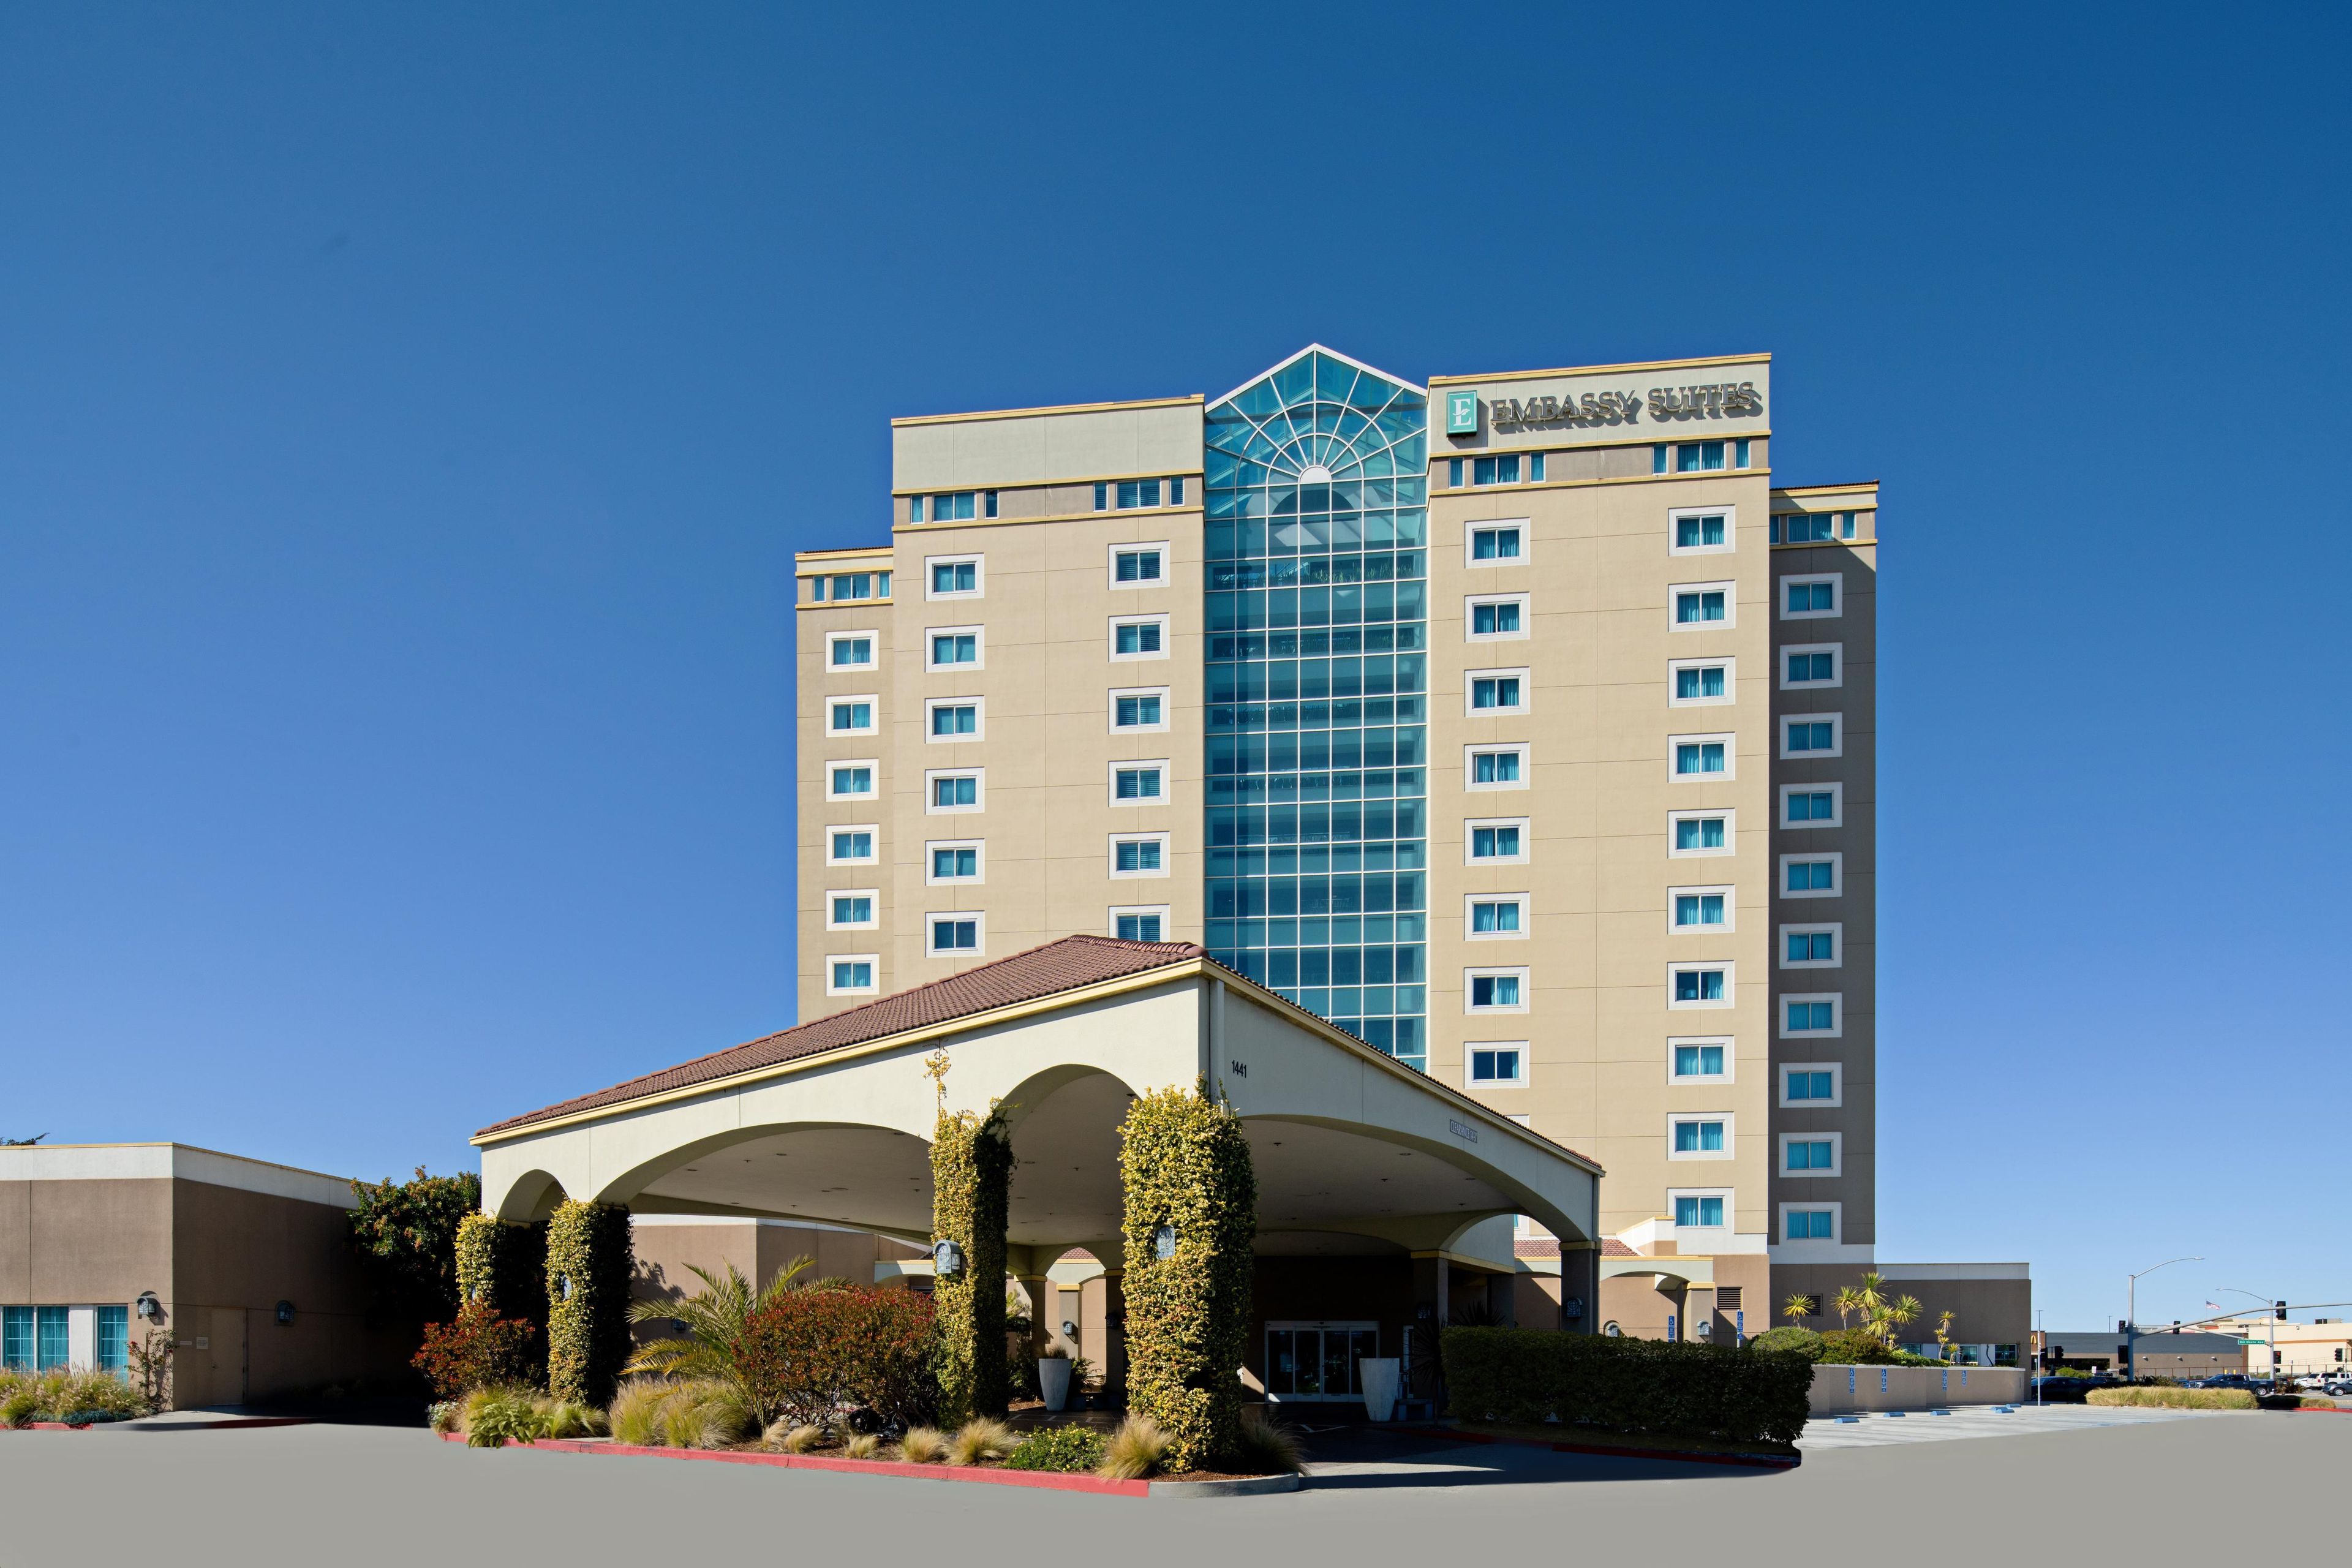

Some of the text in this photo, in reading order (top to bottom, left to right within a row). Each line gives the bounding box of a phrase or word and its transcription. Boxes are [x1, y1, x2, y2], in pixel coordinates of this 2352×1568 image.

[1452, 398, 1472, 426] E
[1490, 382, 1756, 423] EMBASSY SUITES
[1232, 1060, 1246, 1078] 1441
